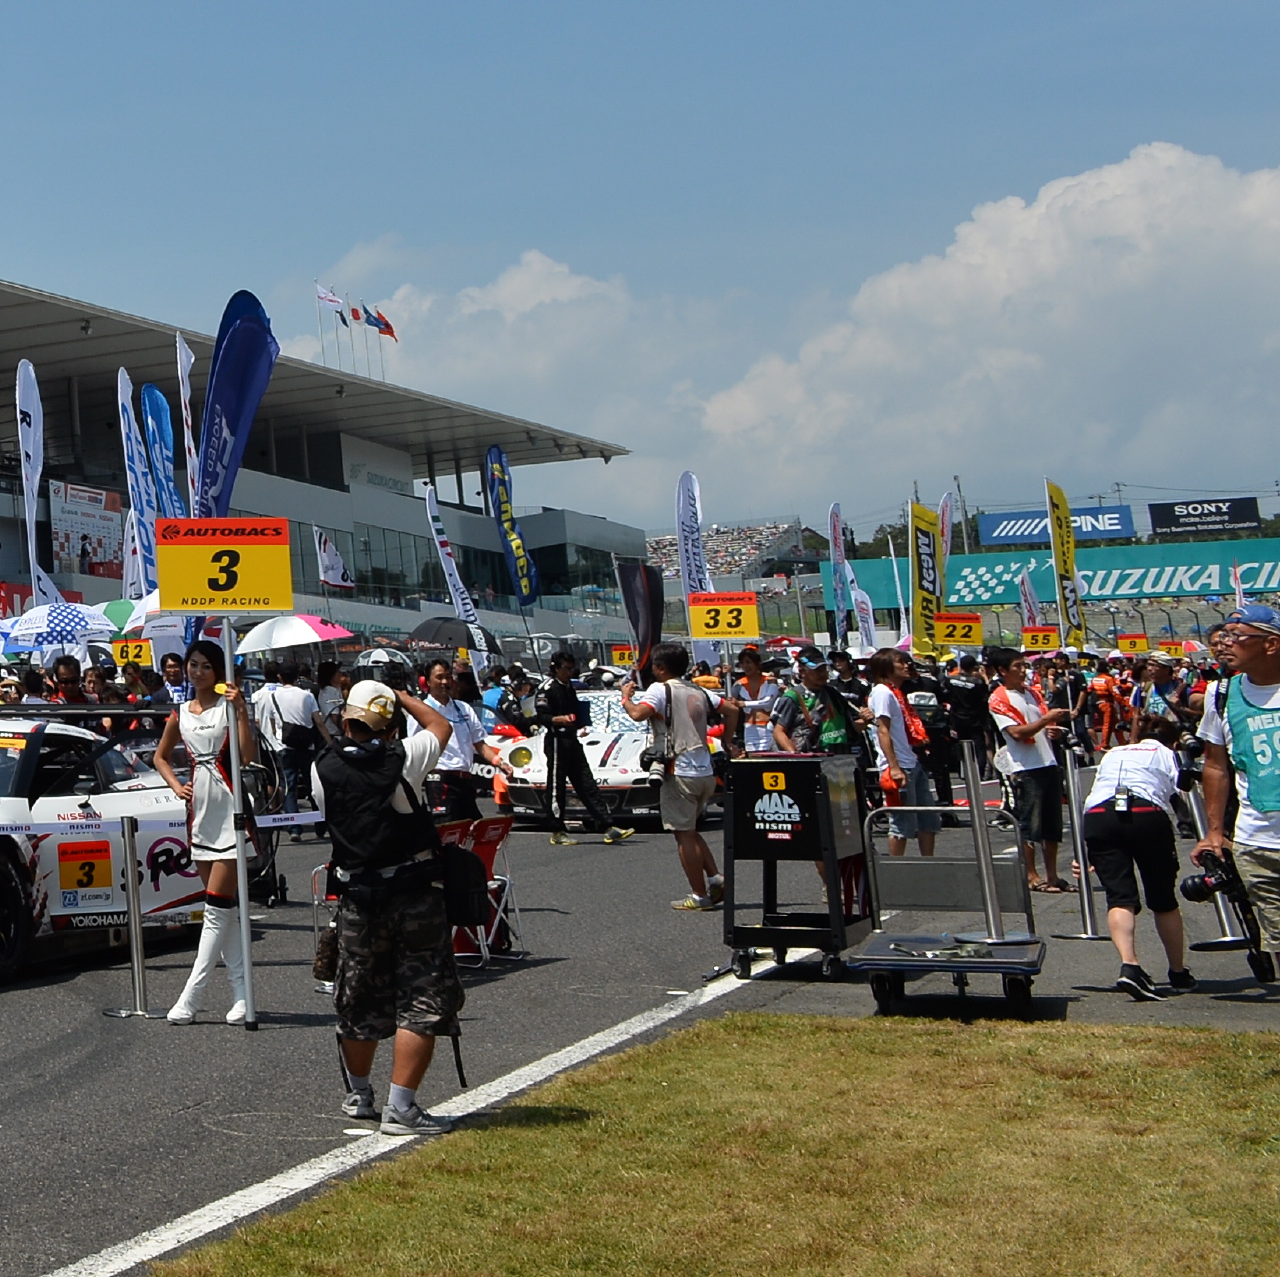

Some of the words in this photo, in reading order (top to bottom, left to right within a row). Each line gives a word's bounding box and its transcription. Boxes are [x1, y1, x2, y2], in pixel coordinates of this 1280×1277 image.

[1174, 502, 1232, 516] SONY
[183, 527, 282, 537] AUTOBACS
[207, 549, 241, 592] 3
[1076, 565, 1221, 597] SUZUKA
[181, 597, 216, 606] NDDP
[221, 597, 270, 605] RACING
[703, 607, 743, 630] 33
[945, 624, 973, 638] 22
[1030, 634, 1052, 645] 55
[1128, 639, 1137, 649] 9
[119, 644, 143, 660] 62
[769, 775, 779, 787] 3
[754, 792, 801, 813] MAC
[57, 811, 103, 821] NISSAN
[754, 813, 802, 822] TOOLS
[755, 822, 803, 831] nismo
[76, 861, 96, 889] 3
